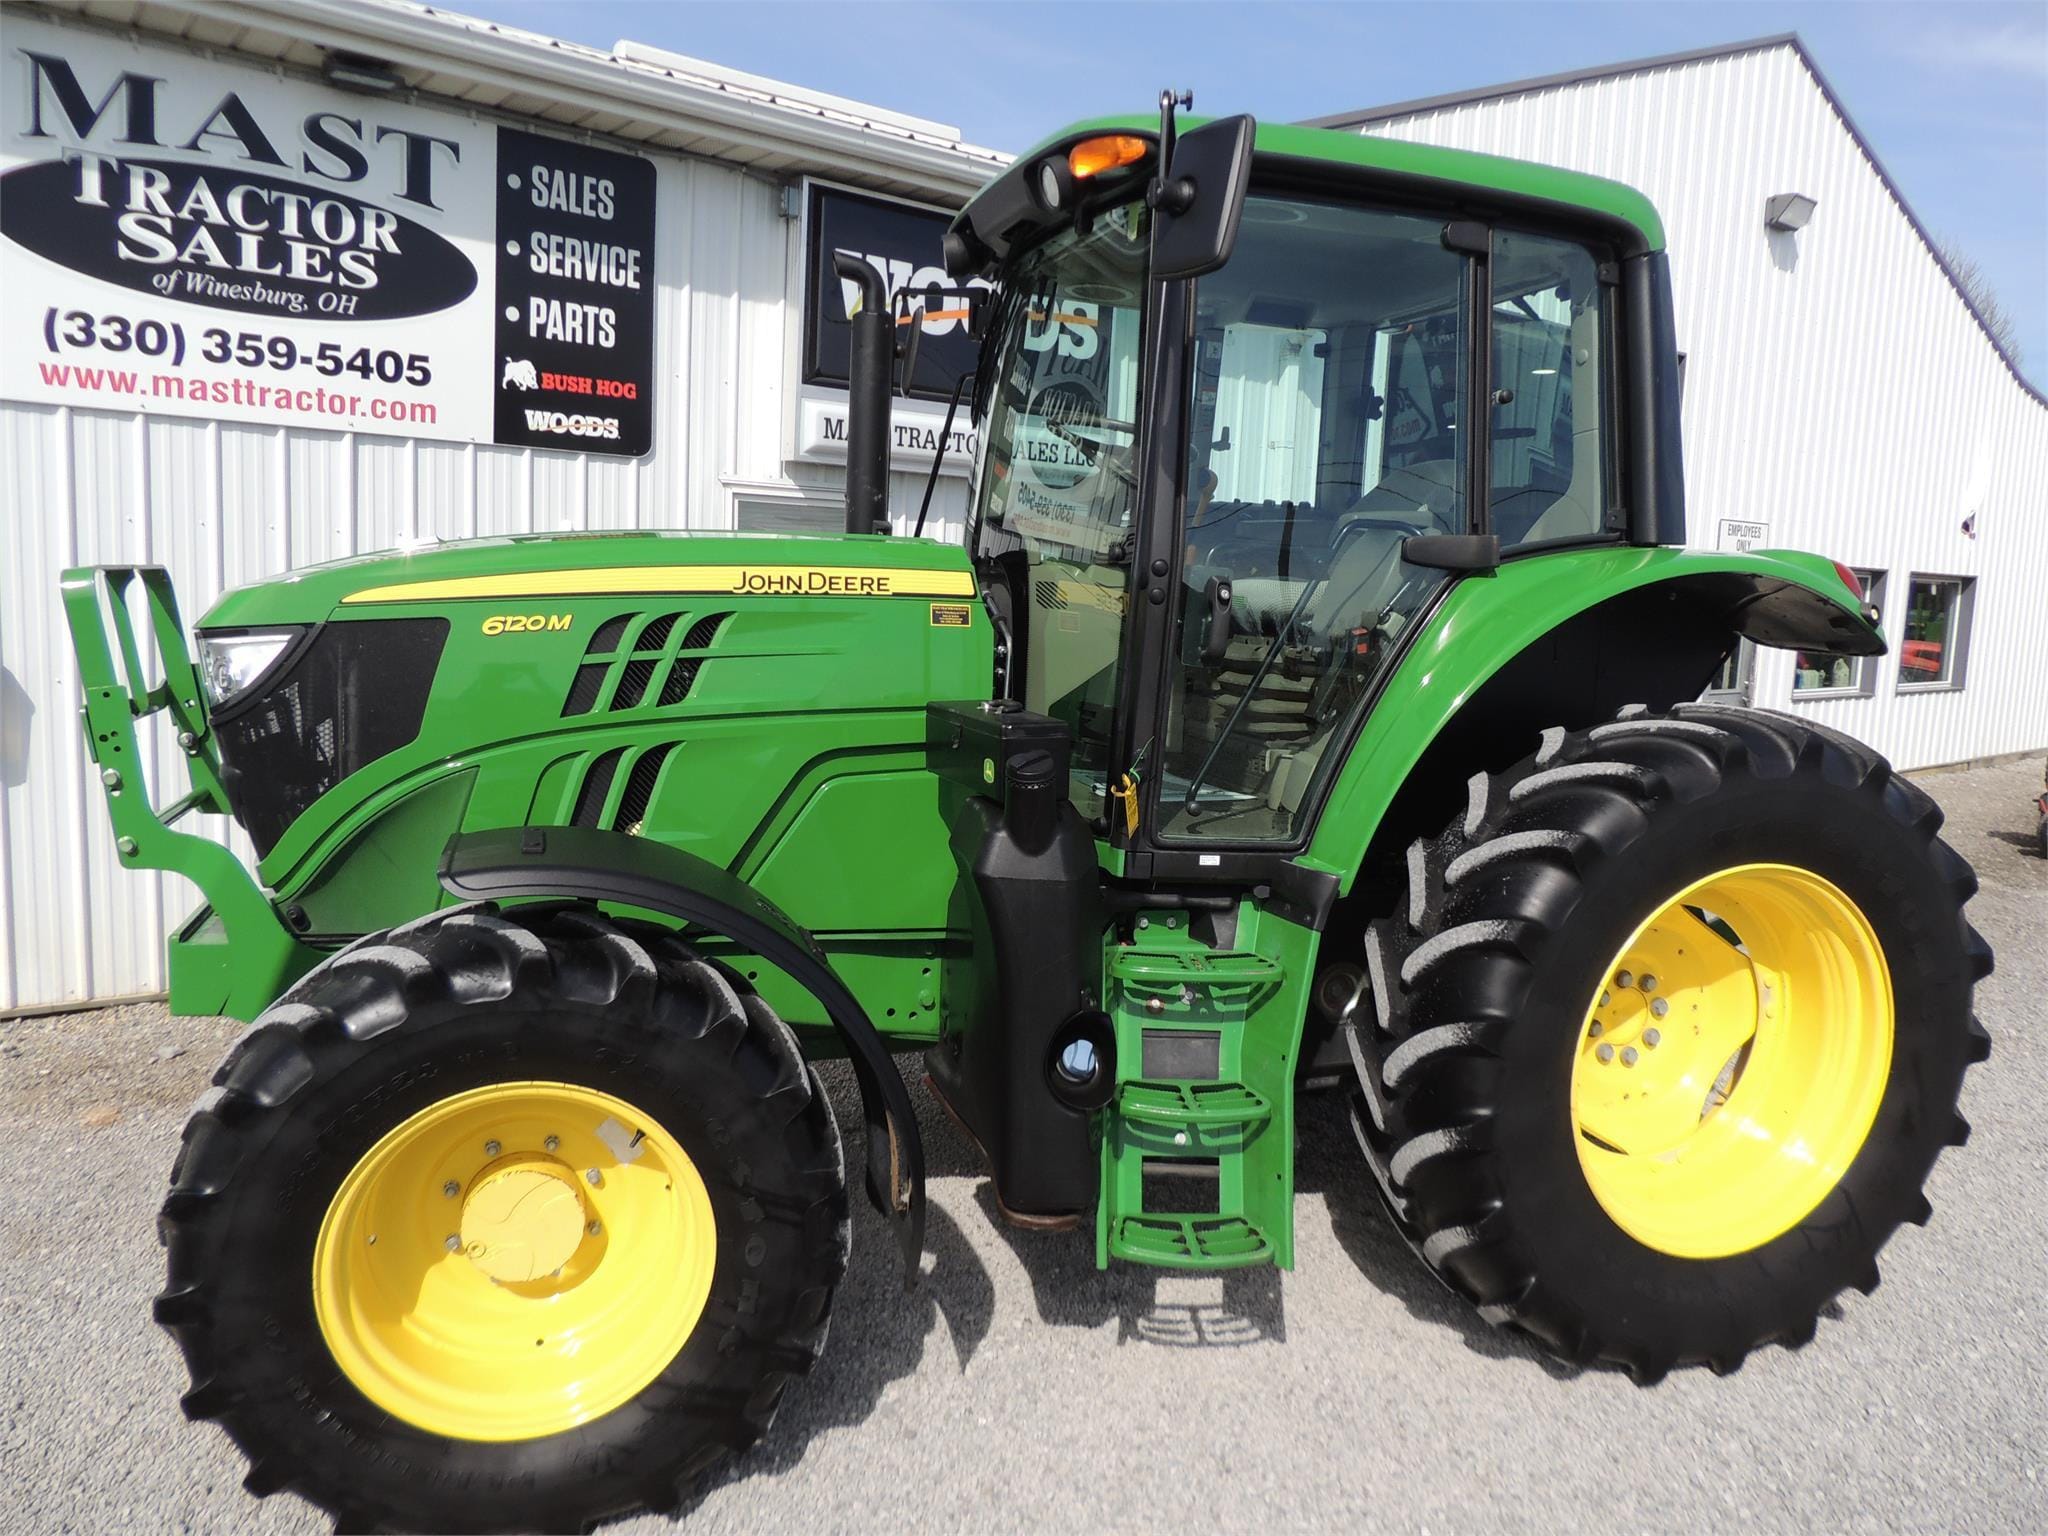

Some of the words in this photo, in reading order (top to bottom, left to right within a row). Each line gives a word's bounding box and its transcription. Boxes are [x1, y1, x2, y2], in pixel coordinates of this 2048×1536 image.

[18, 48, 460, 212] MAST
[62, 146, 402, 255] TRACTOR
[531, 165, 615, 221] SALES
[117, 212, 379, 289] SALES
[530, 231, 641, 289] SERVICE
[152, 269, 183, 295] of
[186, 271, 308, 313] Winesburg,
[318, 292, 359, 315] OH
[833, 247, 1098, 360] WODS
[43, 306, 186, 367] (330)
[202, 327, 432, 387] 359-5405
[529, 296, 616, 348] PARTS
[38, 361, 438, 425] www.masttractor.com
[541, 372, 593, 395] BUSH
[596, 379, 637, 400] HOG
[524, 409, 619, 440] WOODS
[894, 425, 978, 455] TRACTO
[1013, 440, 1059, 464] ALES
[1728, 523, 1761, 539] EMPLOYEES
[733, 571, 802, 591] JOHN
[807, 571, 891, 592] DEERE
[481, 613, 574, 636] 6120M
